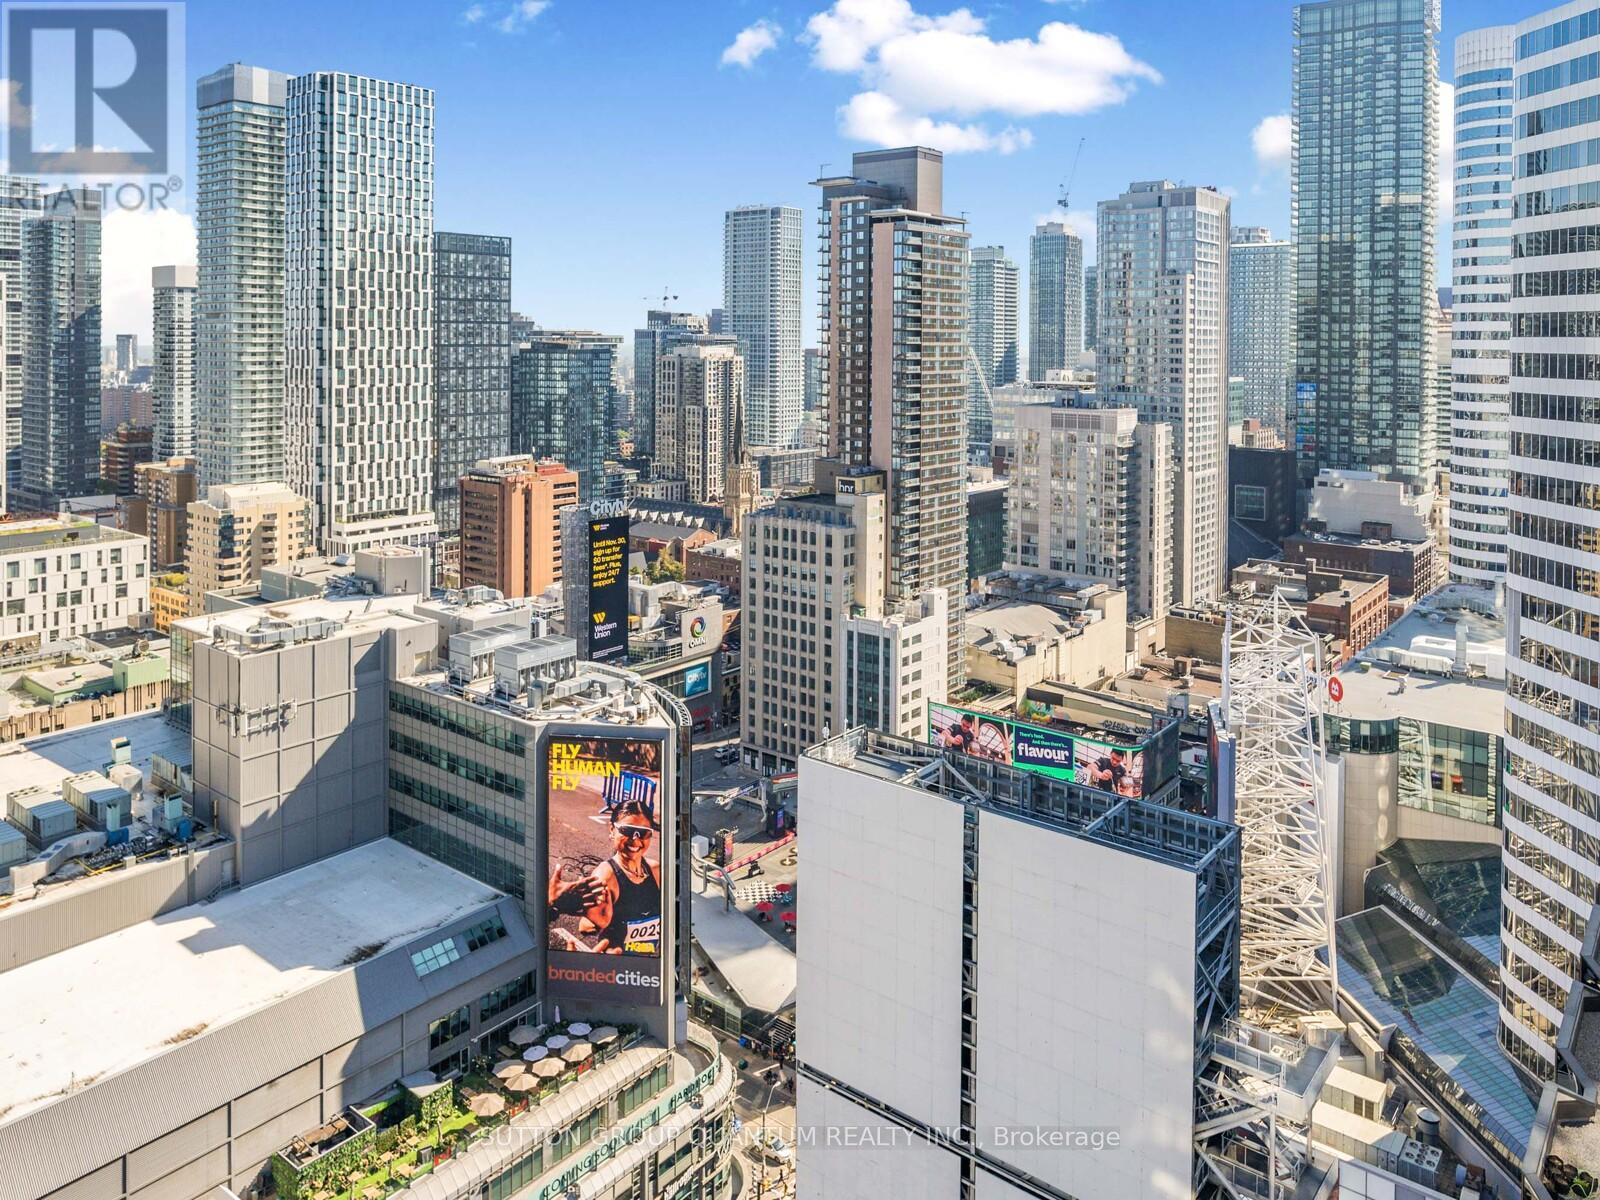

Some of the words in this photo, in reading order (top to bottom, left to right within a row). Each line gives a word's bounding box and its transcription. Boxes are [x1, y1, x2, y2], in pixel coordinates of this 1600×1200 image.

[839, 480, 854, 492] hnr
[590, 499, 626, 517] Citytv
[594, 622, 617, 632] Western
[594, 630, 611, 639] Union
[552, 743, 581, 759] FLY
[1017, 742, 1069, 760] flavour
[552, 759, 620, 778] HUMAN
[552, 775, 580, 791] FLY
